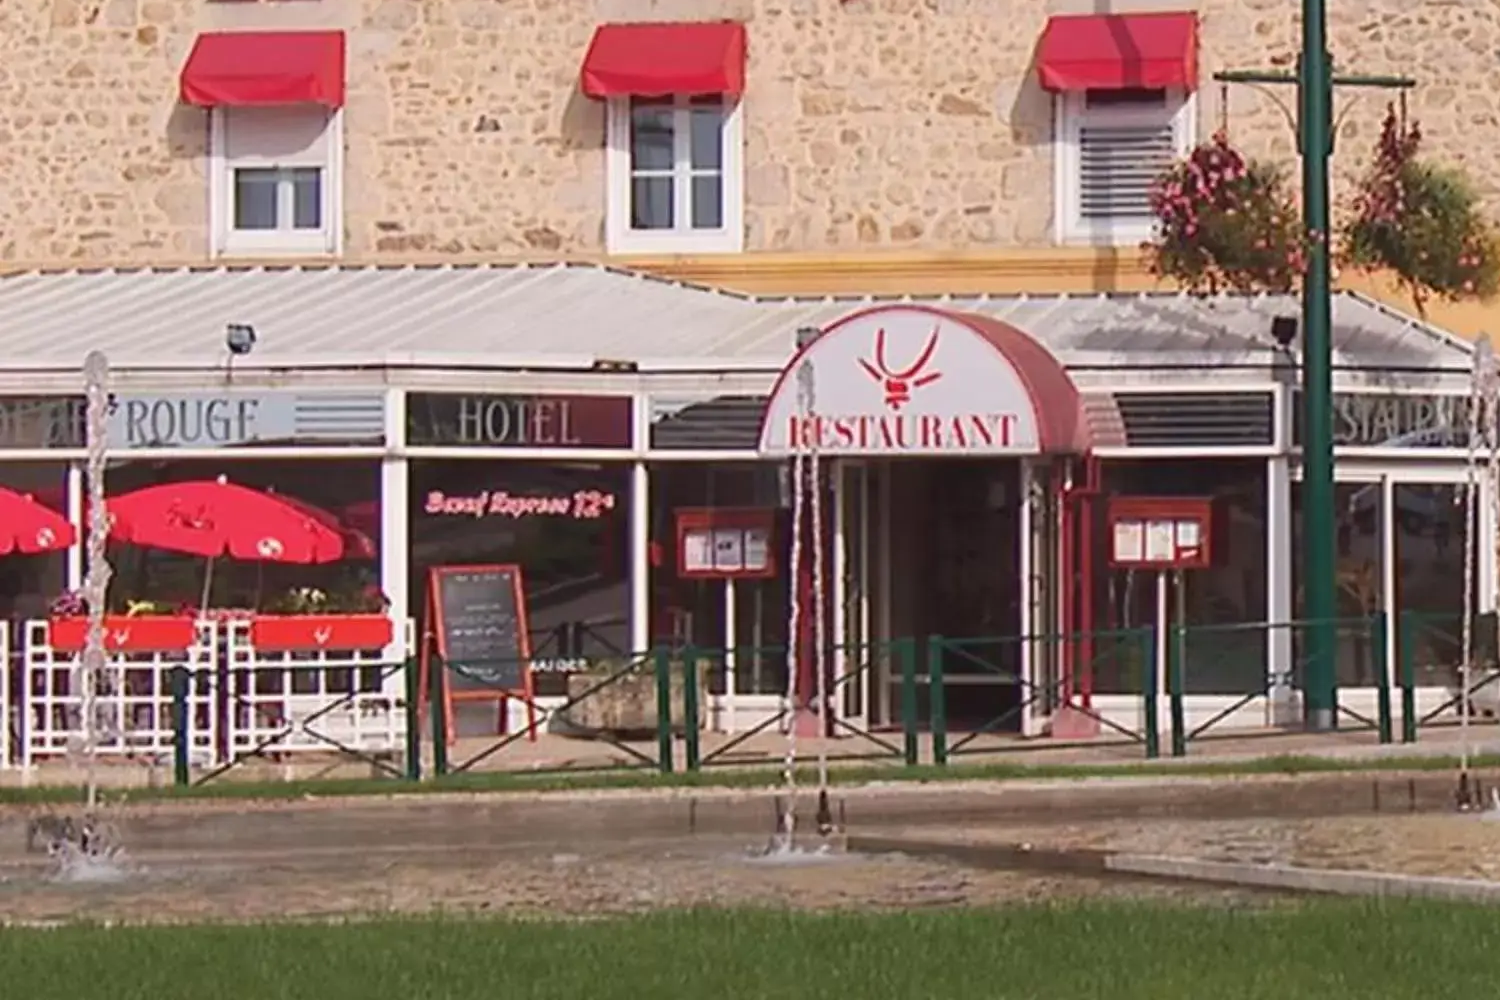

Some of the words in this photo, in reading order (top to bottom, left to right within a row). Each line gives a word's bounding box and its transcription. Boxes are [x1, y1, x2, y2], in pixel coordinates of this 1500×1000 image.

[126, 398, 260, 446] ROUGE
[459, 397, 581, 444] HOTEL
[788, 412, 1018, 448] RESTAURANT
